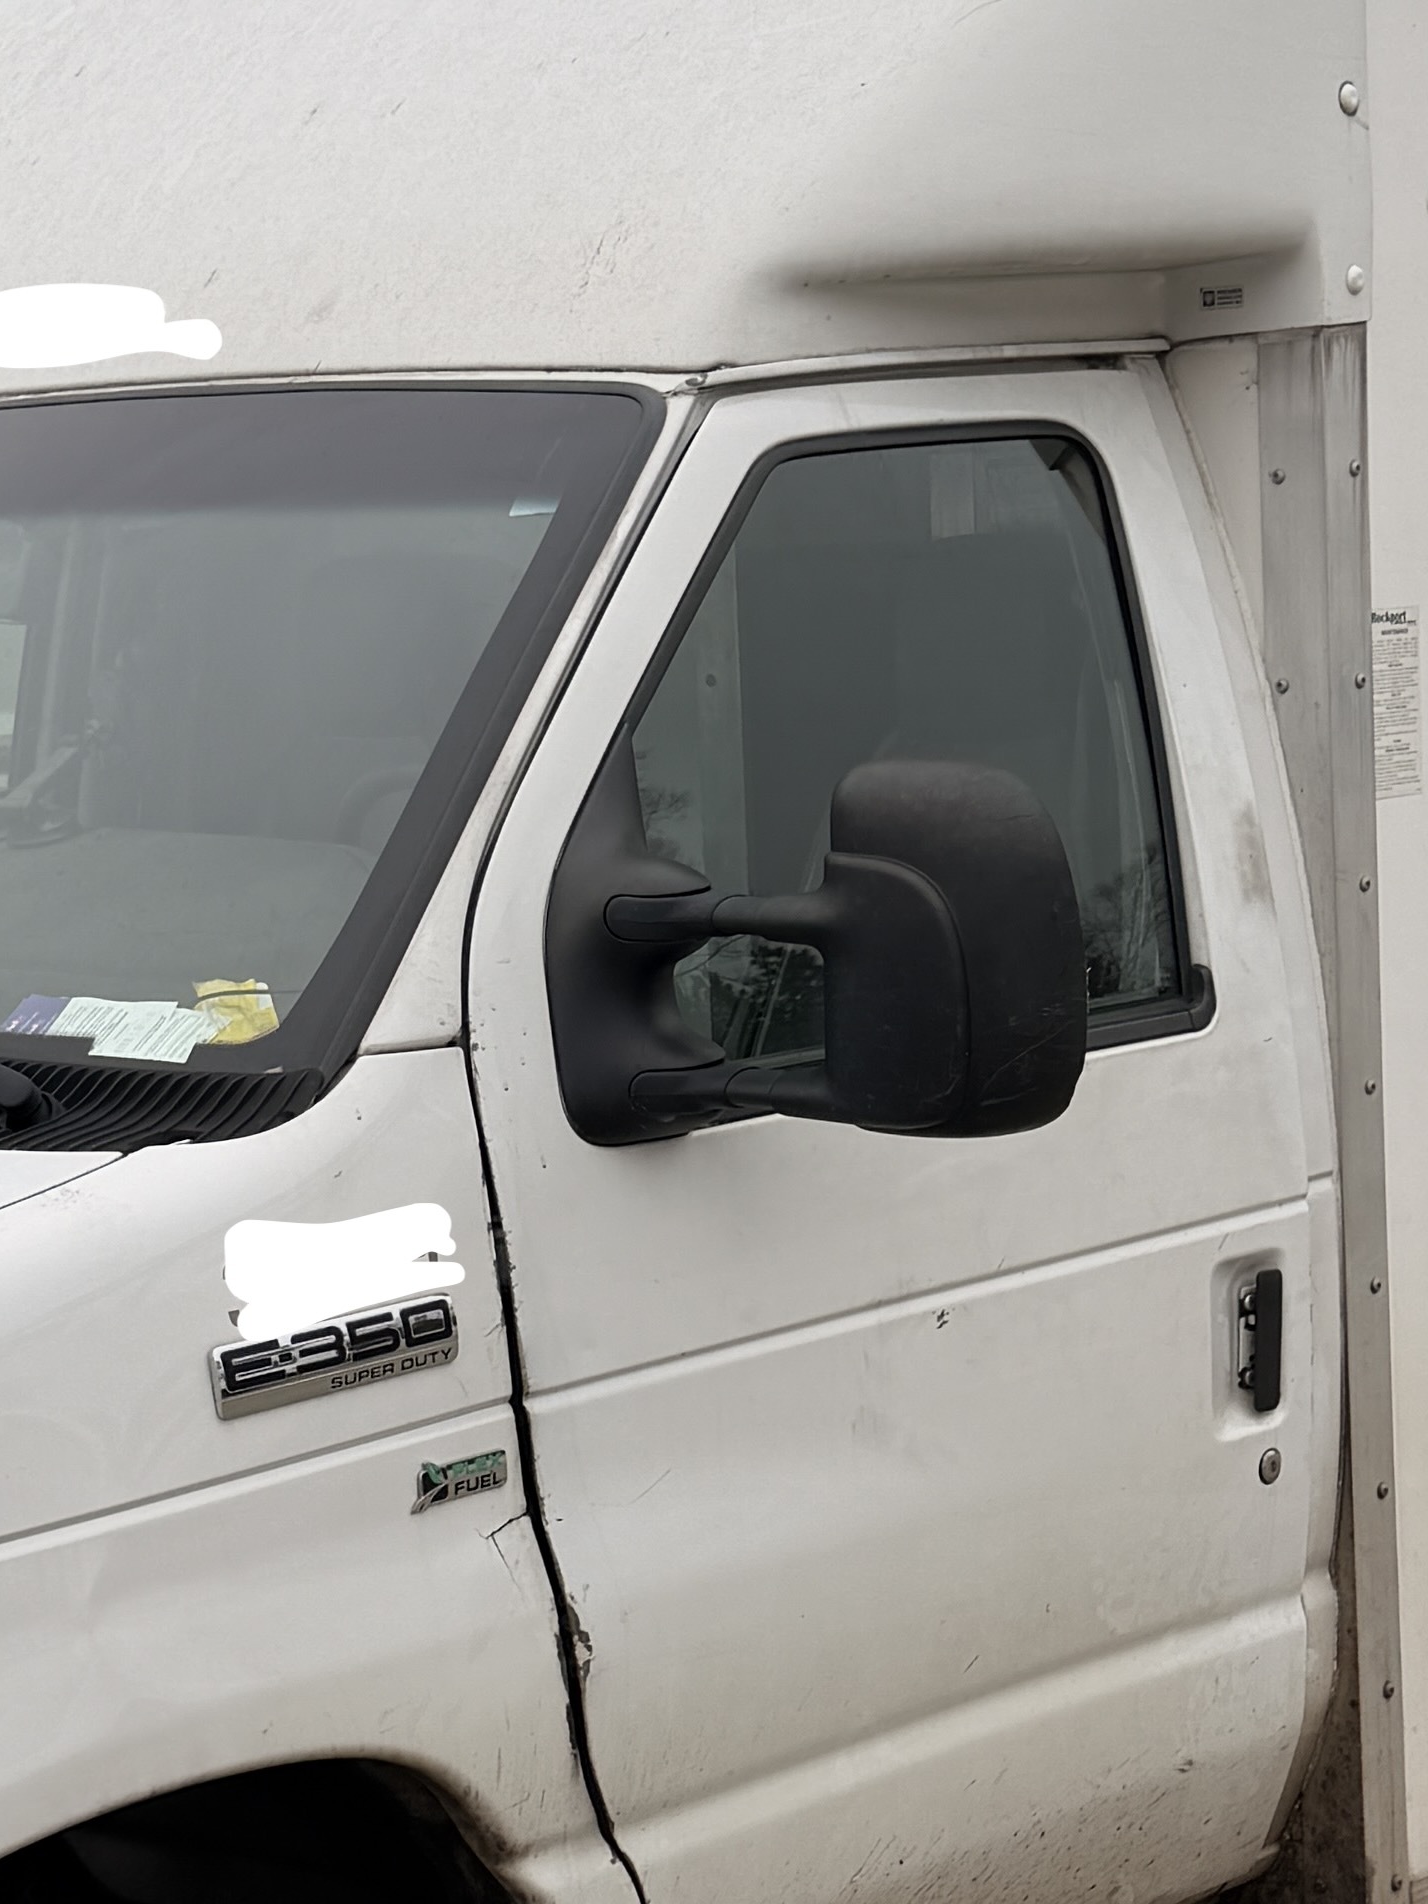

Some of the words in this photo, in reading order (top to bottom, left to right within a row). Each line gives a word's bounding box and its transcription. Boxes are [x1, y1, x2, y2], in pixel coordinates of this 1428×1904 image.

[330, 1361, 396, 1389] SUPER
[400, 1347, 453, 1372] DUTY
[453, 1470, 503, 1496] FUEL
